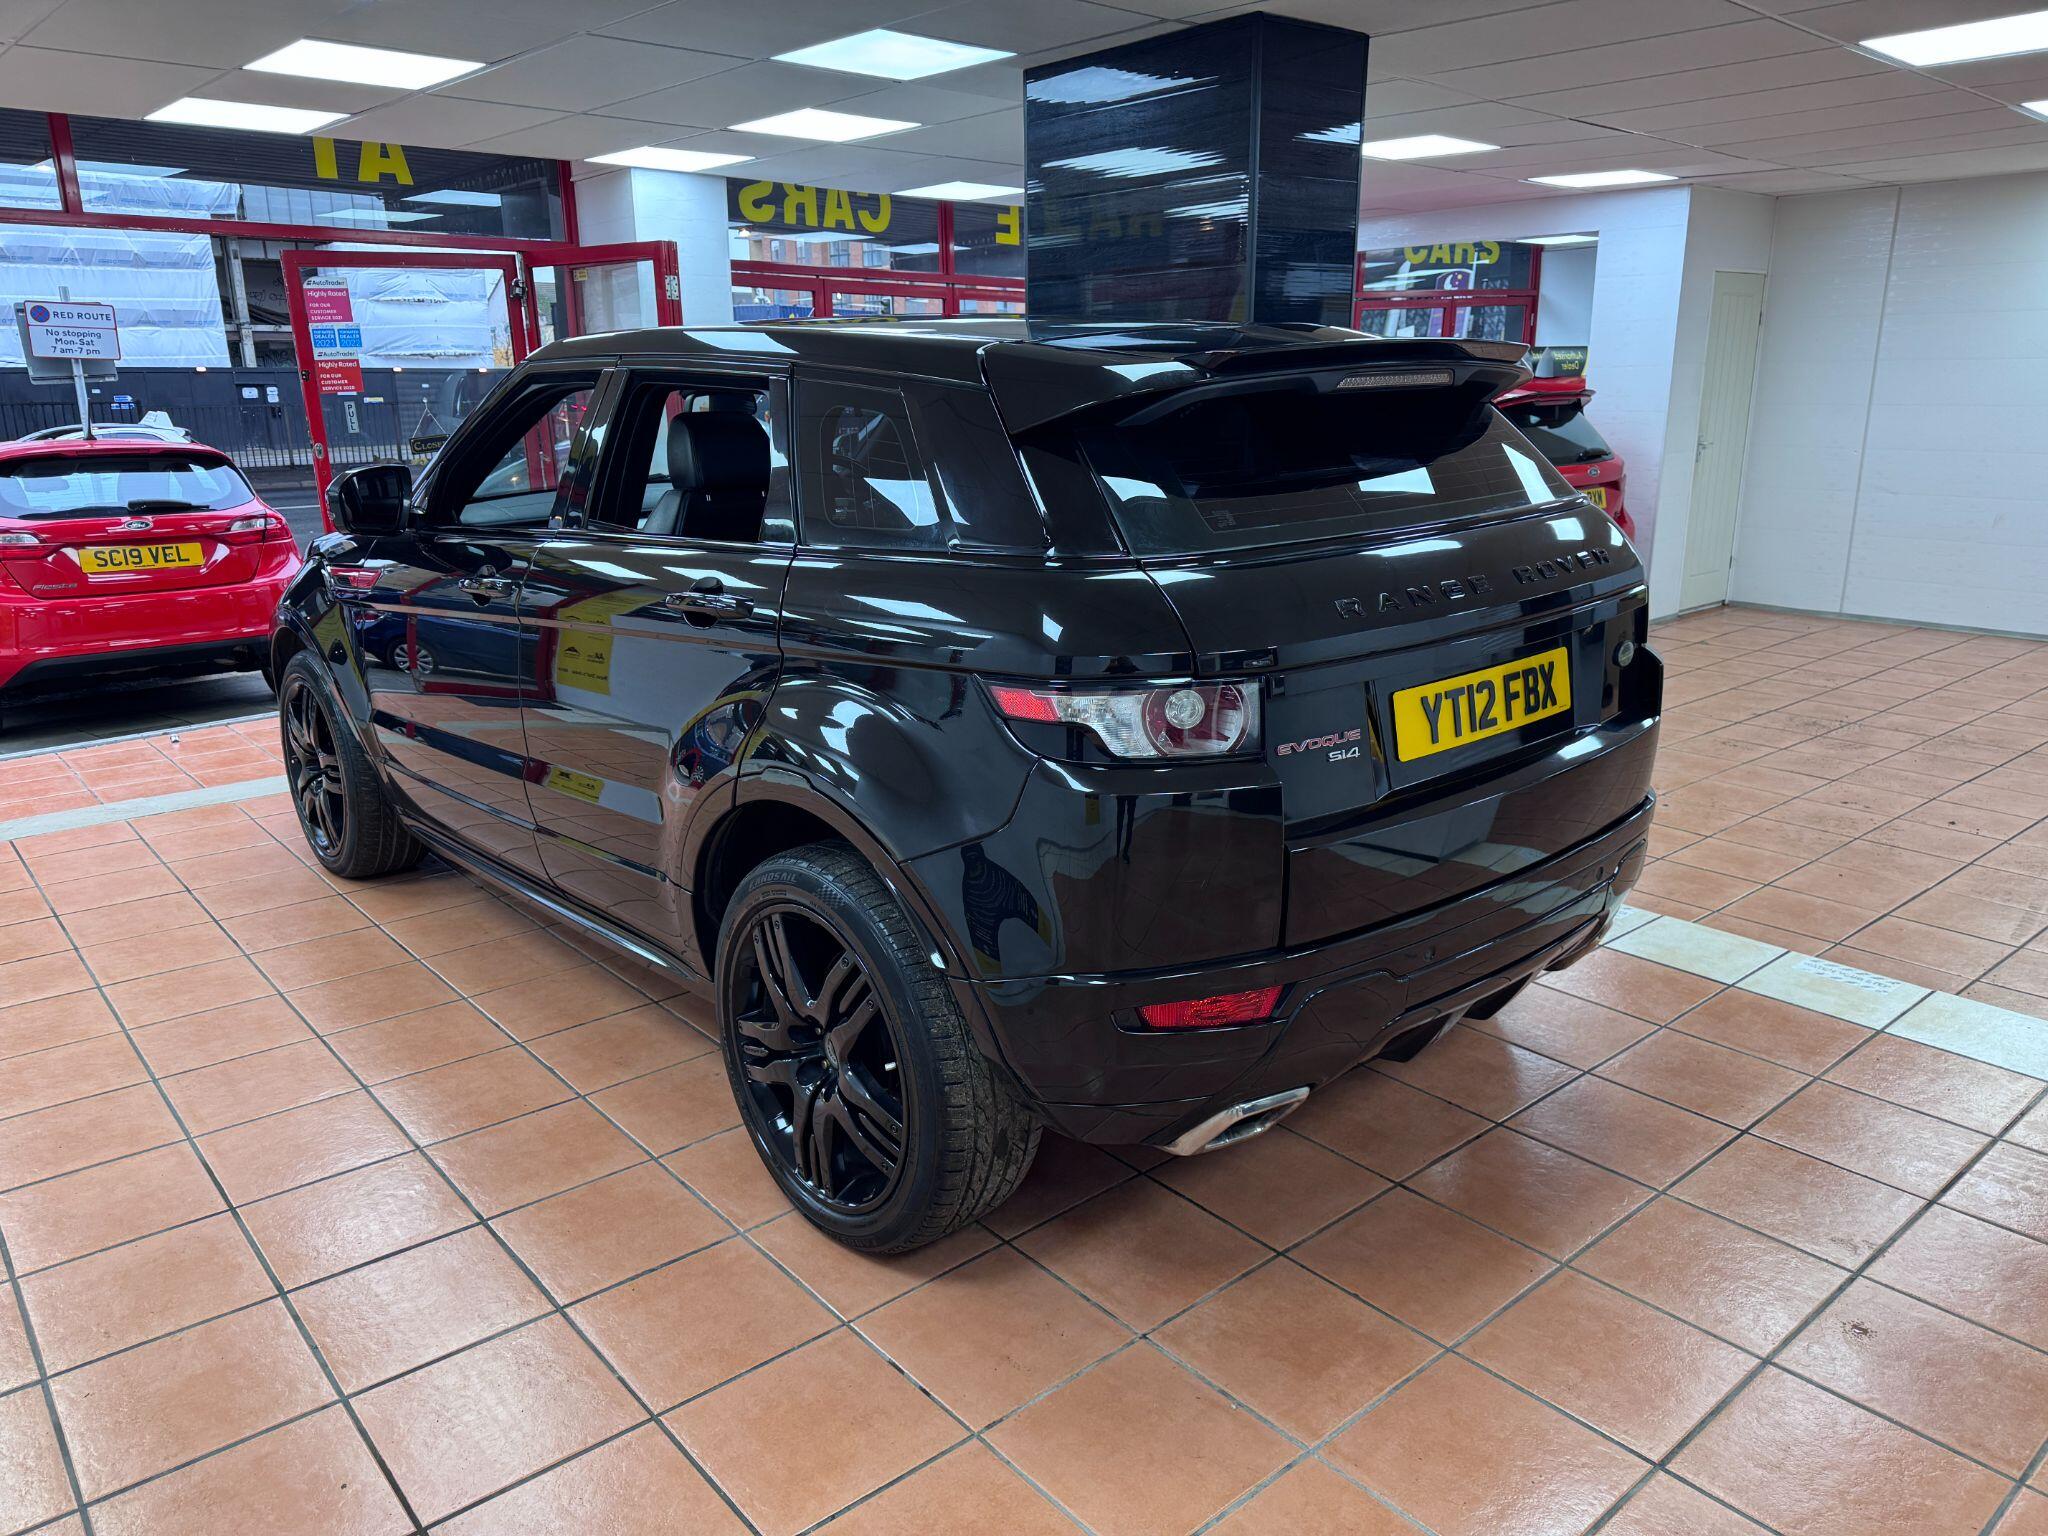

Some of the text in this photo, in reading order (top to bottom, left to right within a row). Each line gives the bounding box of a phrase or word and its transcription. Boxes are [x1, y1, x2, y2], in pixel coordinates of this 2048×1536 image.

[307, 290, 327, 298] Highly
[53, 311, 112, 321] RED ROUTE
[45, 328, 102, 339] No stopping
[54, 338, 95, 346] Mon-Sat
[318, 361, 338, 369] Highly
[347, 404, 356, 431] PULL
[94, 545, 190, 568] SC19 VEL
[32, 583, 78, 591] Fiesta
[1334, 547, 1610, 619] RANGE ROVER
[1420, 660, 1558, 745] YT12 FBX
[1276, 728, 1361, 756] EVOQUE
